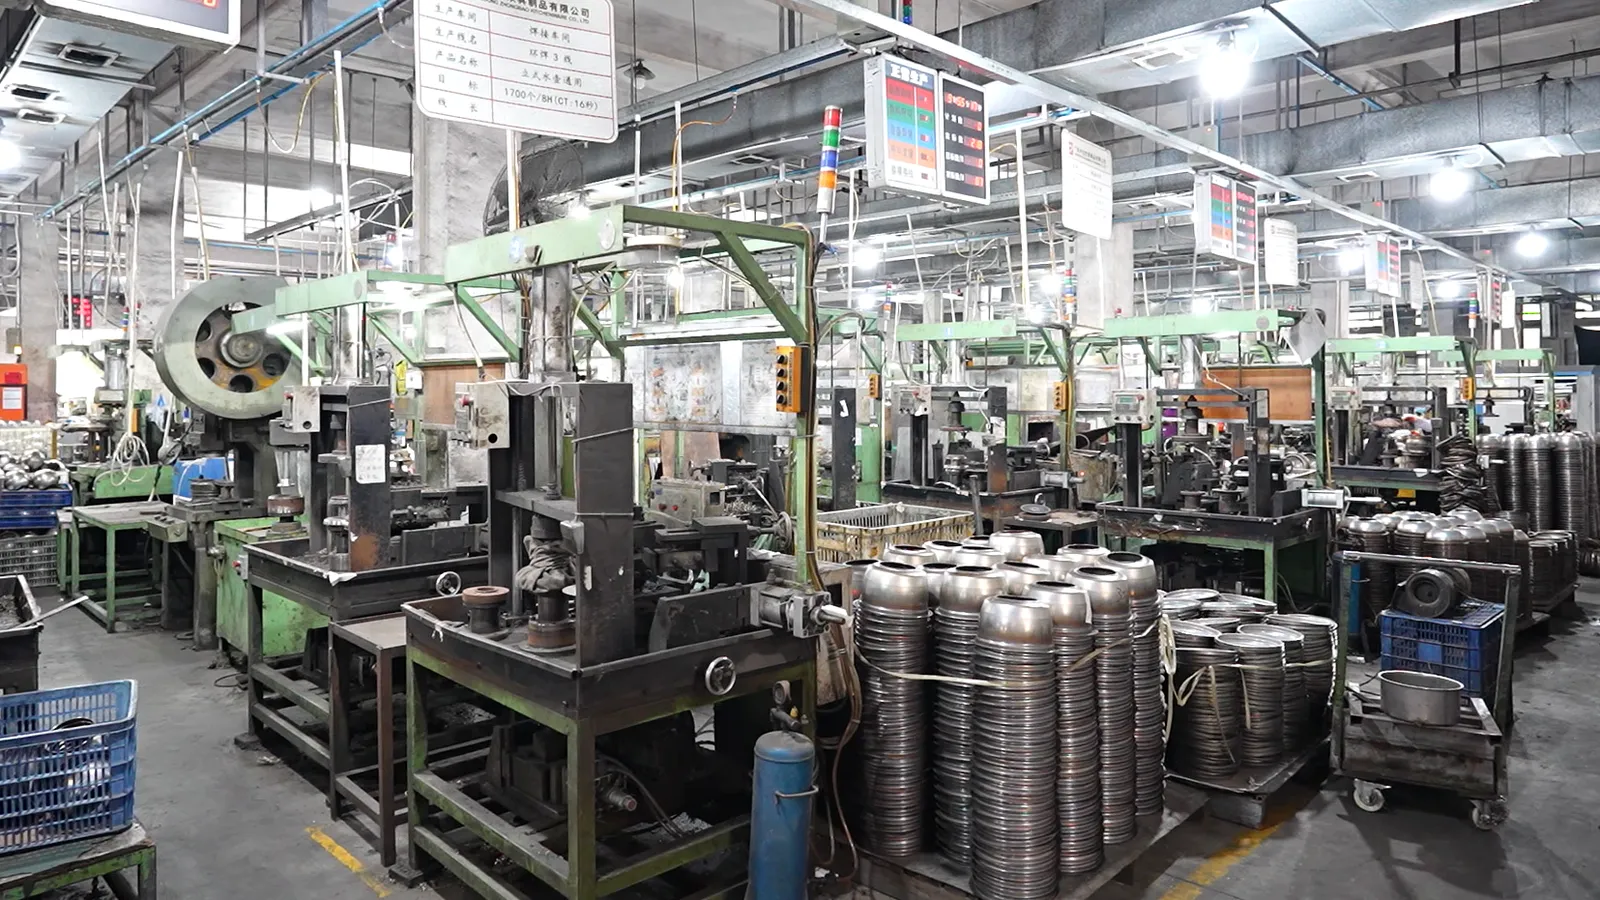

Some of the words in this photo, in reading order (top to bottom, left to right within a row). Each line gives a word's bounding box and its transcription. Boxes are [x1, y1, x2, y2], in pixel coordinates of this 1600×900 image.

[434, 3, 477, 23] 生产车间
[435, 26, 478, 45] 生产线名
[529, 26, 571, 43] 焊接车间
[435, 50, 479, 68] 产品名称
